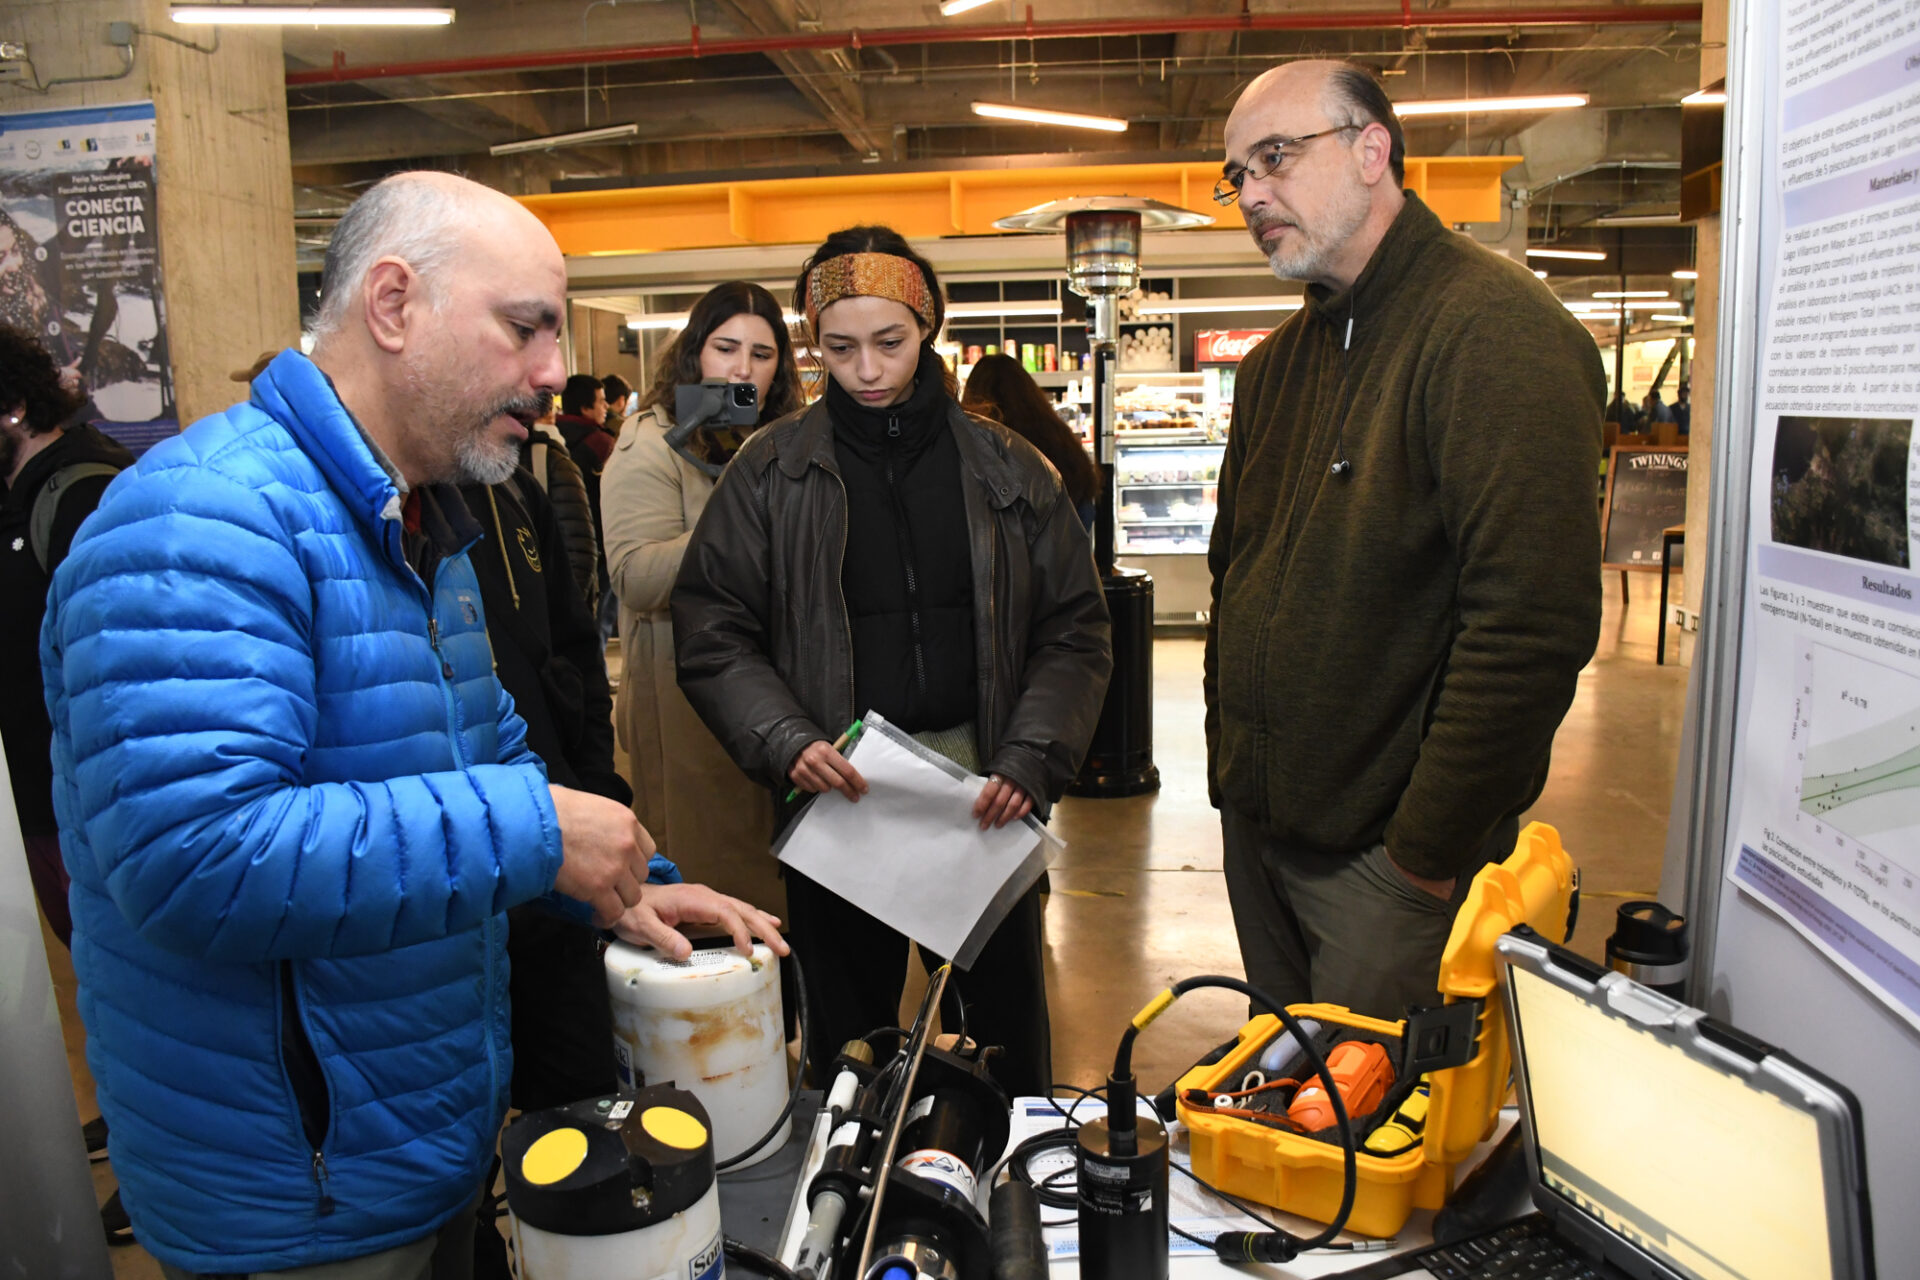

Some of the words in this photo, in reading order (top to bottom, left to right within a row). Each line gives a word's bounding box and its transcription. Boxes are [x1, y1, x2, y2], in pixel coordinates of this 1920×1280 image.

[65, 195, 144, 217] CONECTA
[67, 214, 145, 238] CIENCIA
[1629, 454, 1688, 469] TWININGS
[1862, 576, 1912, 600] Resultados
[694, 1240, 721, 1278] Son
